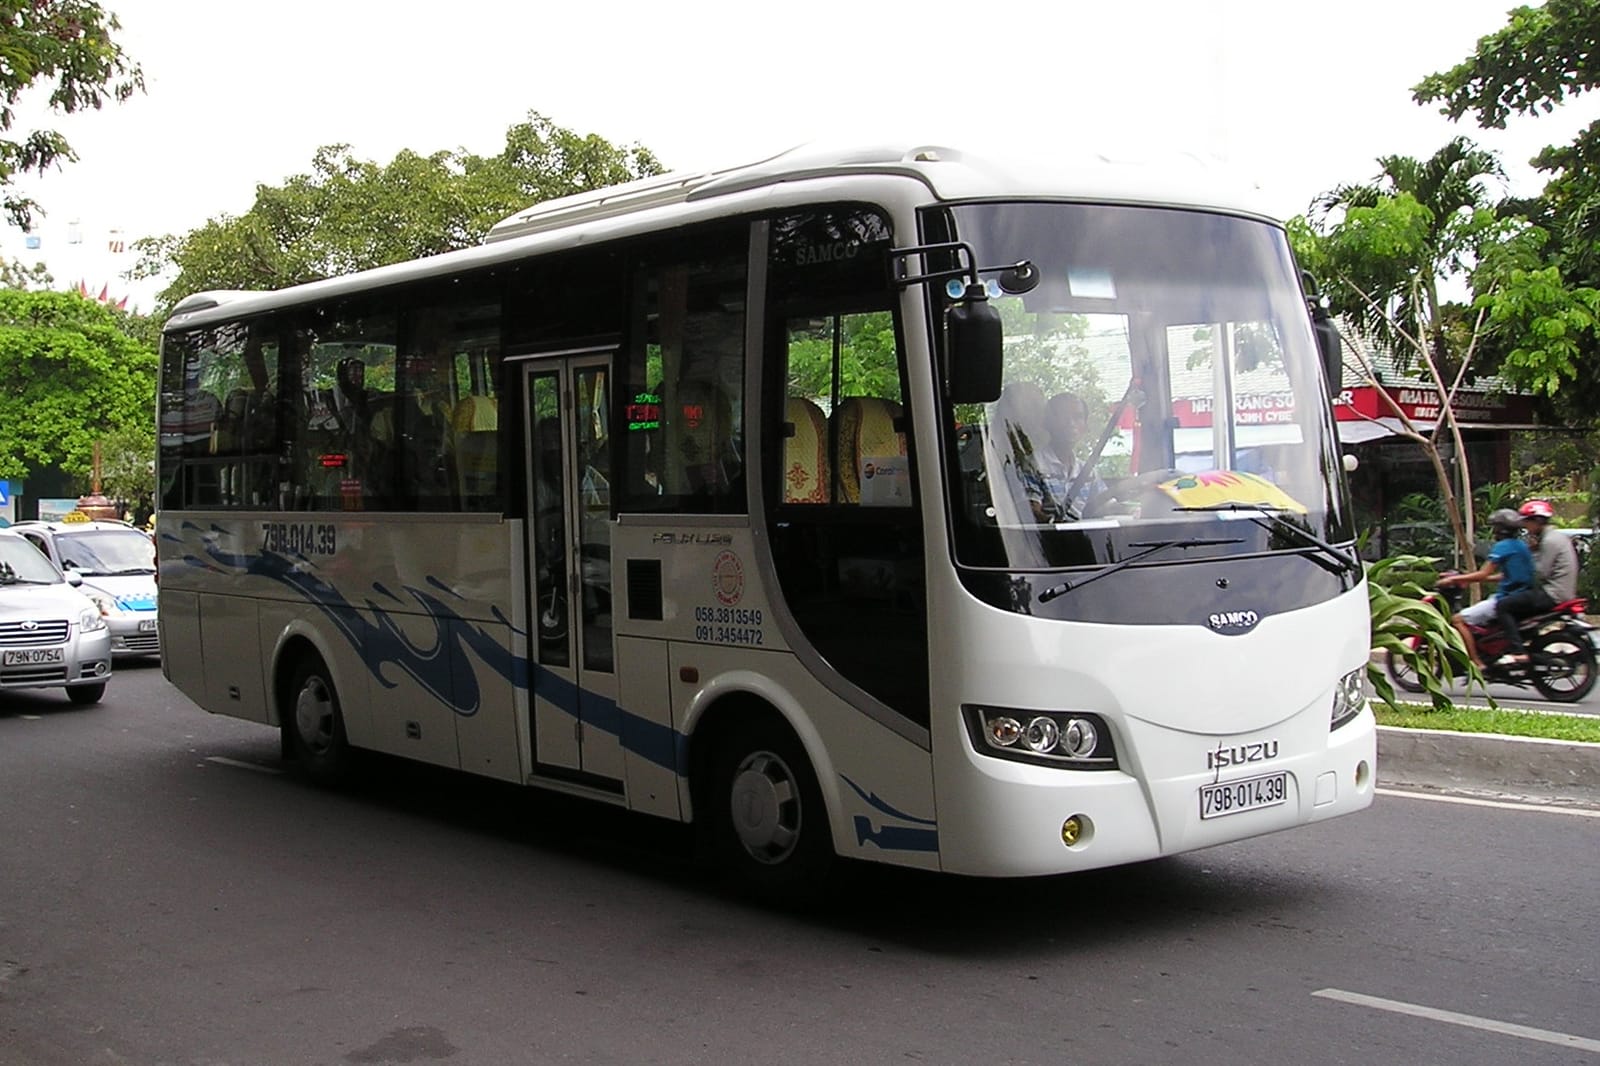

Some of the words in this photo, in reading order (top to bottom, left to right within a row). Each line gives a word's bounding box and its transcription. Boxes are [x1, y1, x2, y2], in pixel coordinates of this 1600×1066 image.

[796, 241, 858, 265] SAMCO
[1191, 399, 1213, 413] NH
[1235, 396, 1273, 410] RANG
[695, 606, 762, 625] 058.3813549
[1209, 611, 1258, 628] SAMCO
[695, 625, 763, 645] 091.3454472
[1207, 741, 1278, 769] ISUZU
[1203, 777, 1284, 813] 79B-014.39
